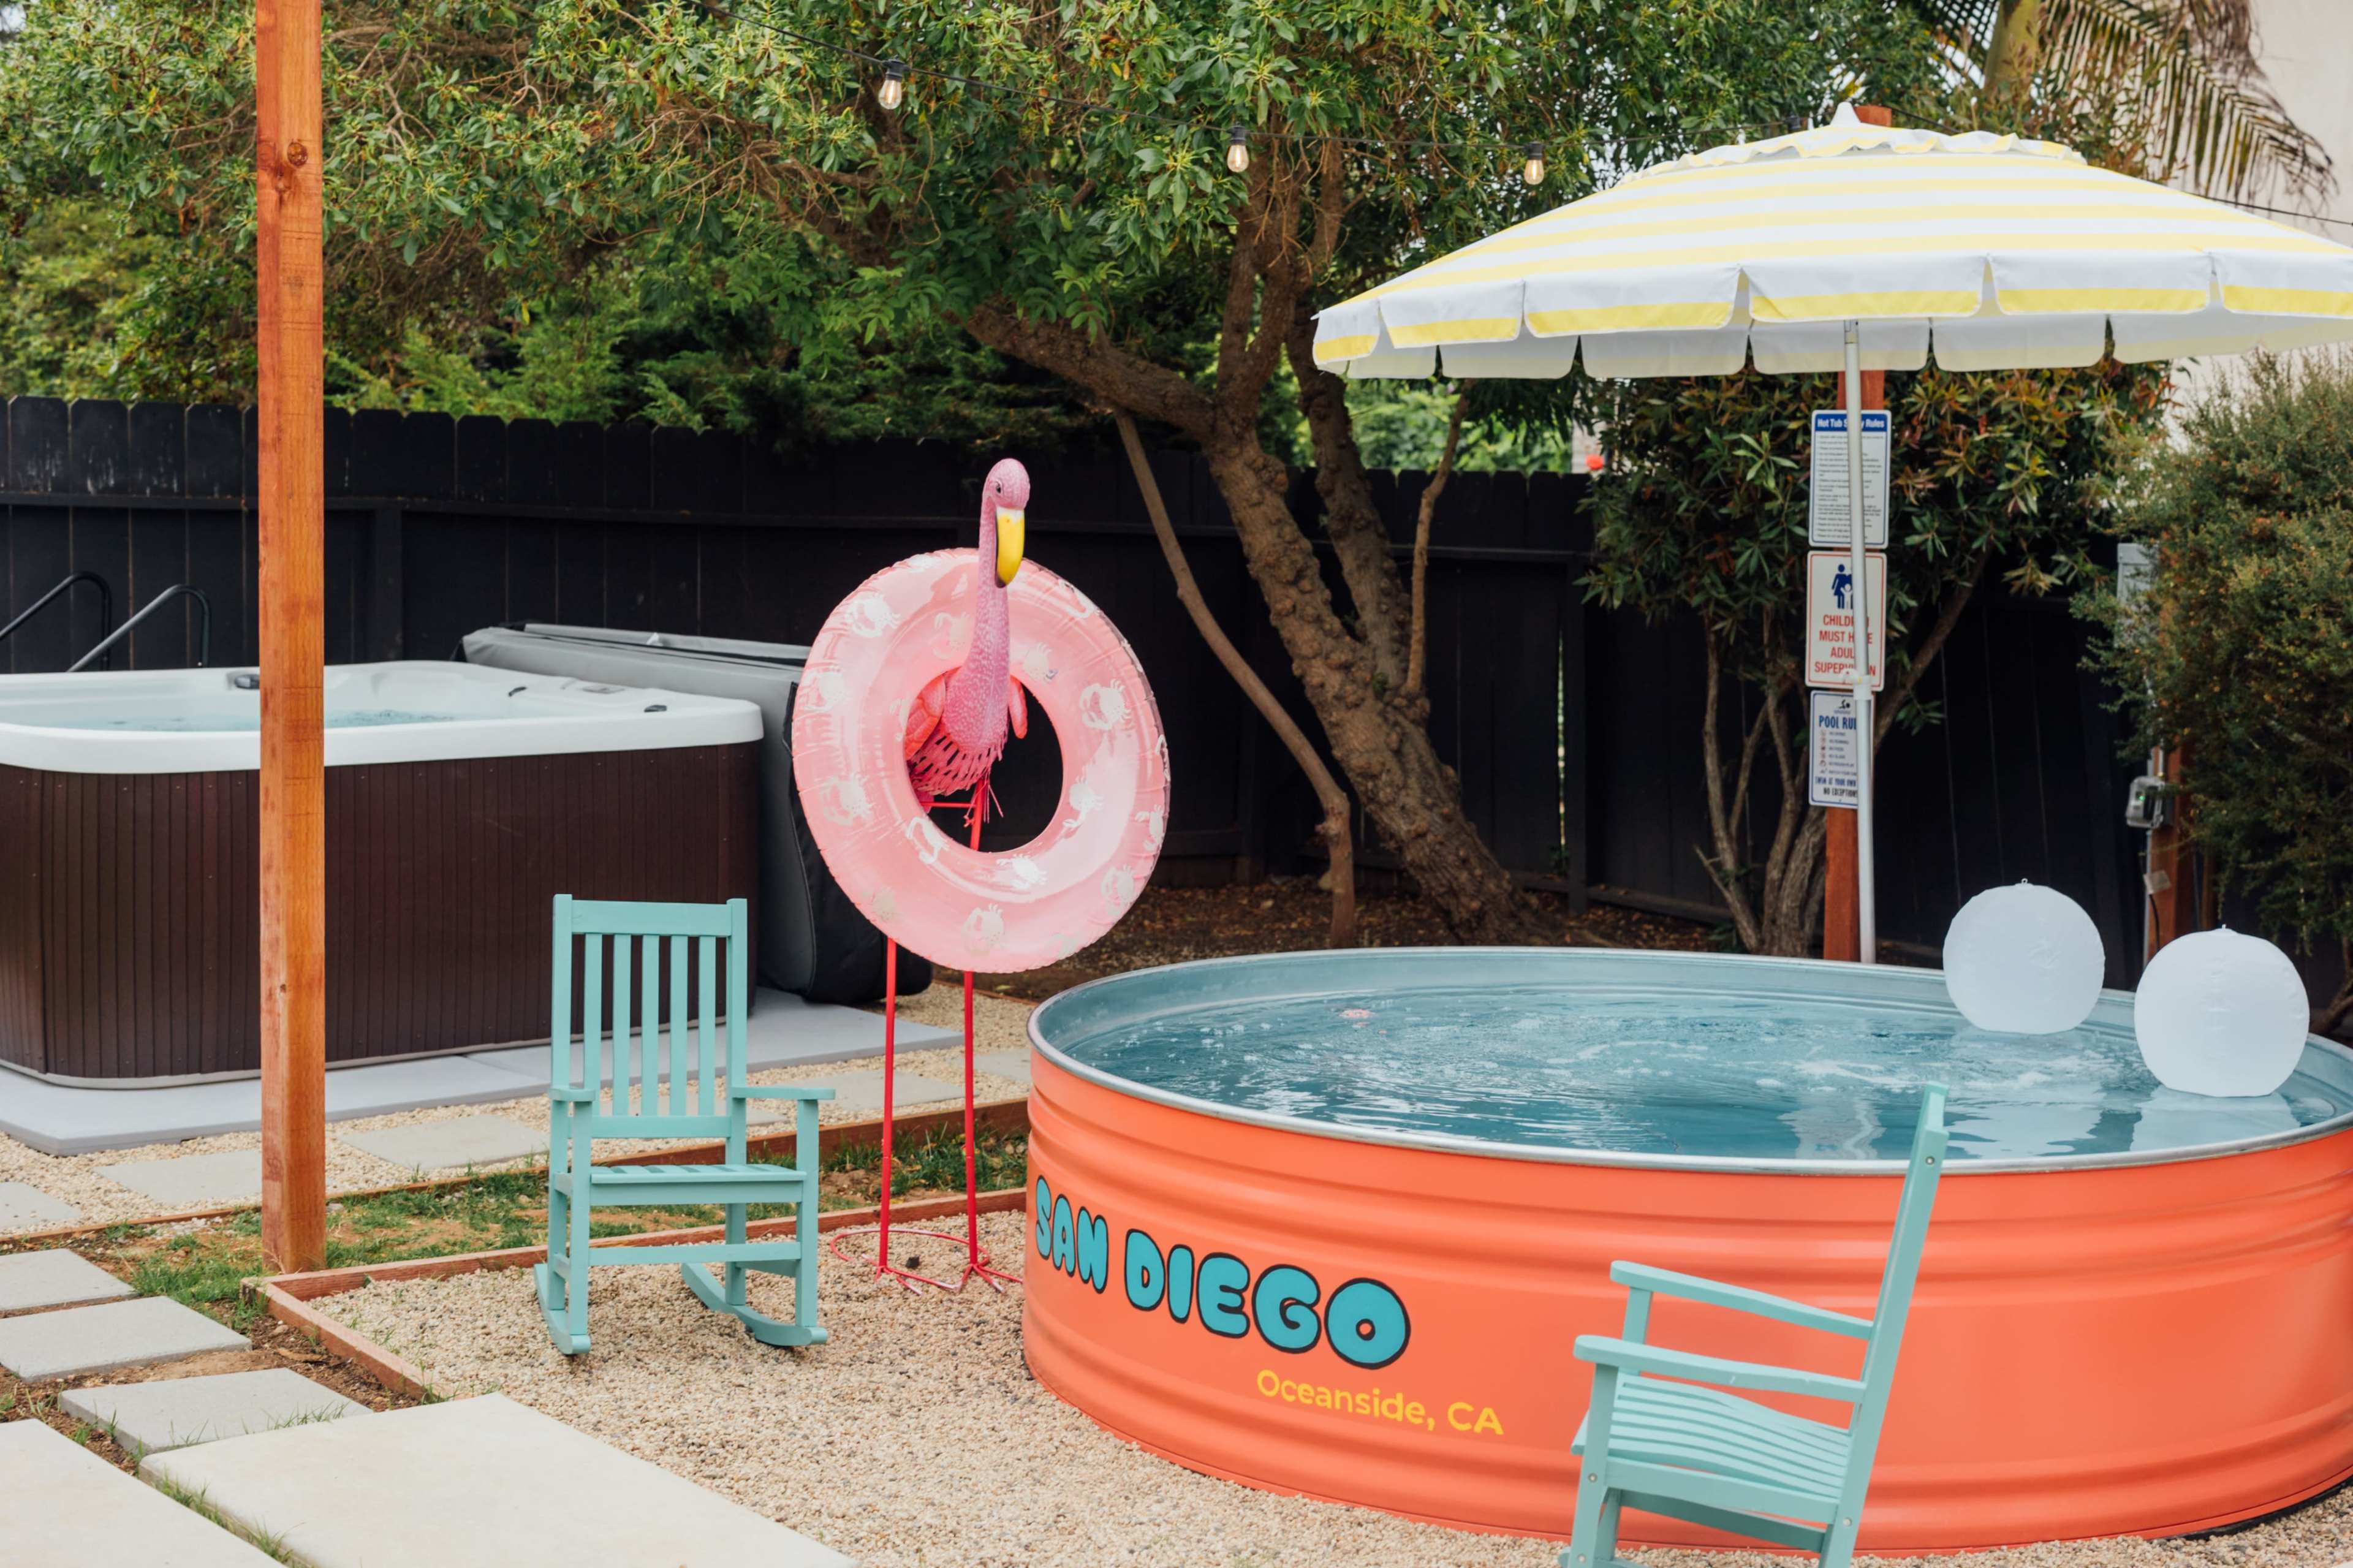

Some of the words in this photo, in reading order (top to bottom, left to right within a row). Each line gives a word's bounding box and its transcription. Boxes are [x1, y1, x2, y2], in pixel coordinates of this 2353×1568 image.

[1830, 419, 1843, 428] Tub
[1865, 419, 1885, 428] Rules
[1823, 615, 1870, 628] CHILD
[1819, 631, 1845, 642] MUST
[1849, 632, 1873, 643] HE
[1830, 647, 1855, 659] ADUL
[1819, 715, 1840, 729] POOL
[1843, 717, 1857, 730] RUL
[1036, 1175, 1108, 1293] SAN
[1124, 1229, 1411, 1369] DIEGO
[1257, 1370, 1436, 1431] Oceanside,
[1447, 1402, 1504, 1436] CA
